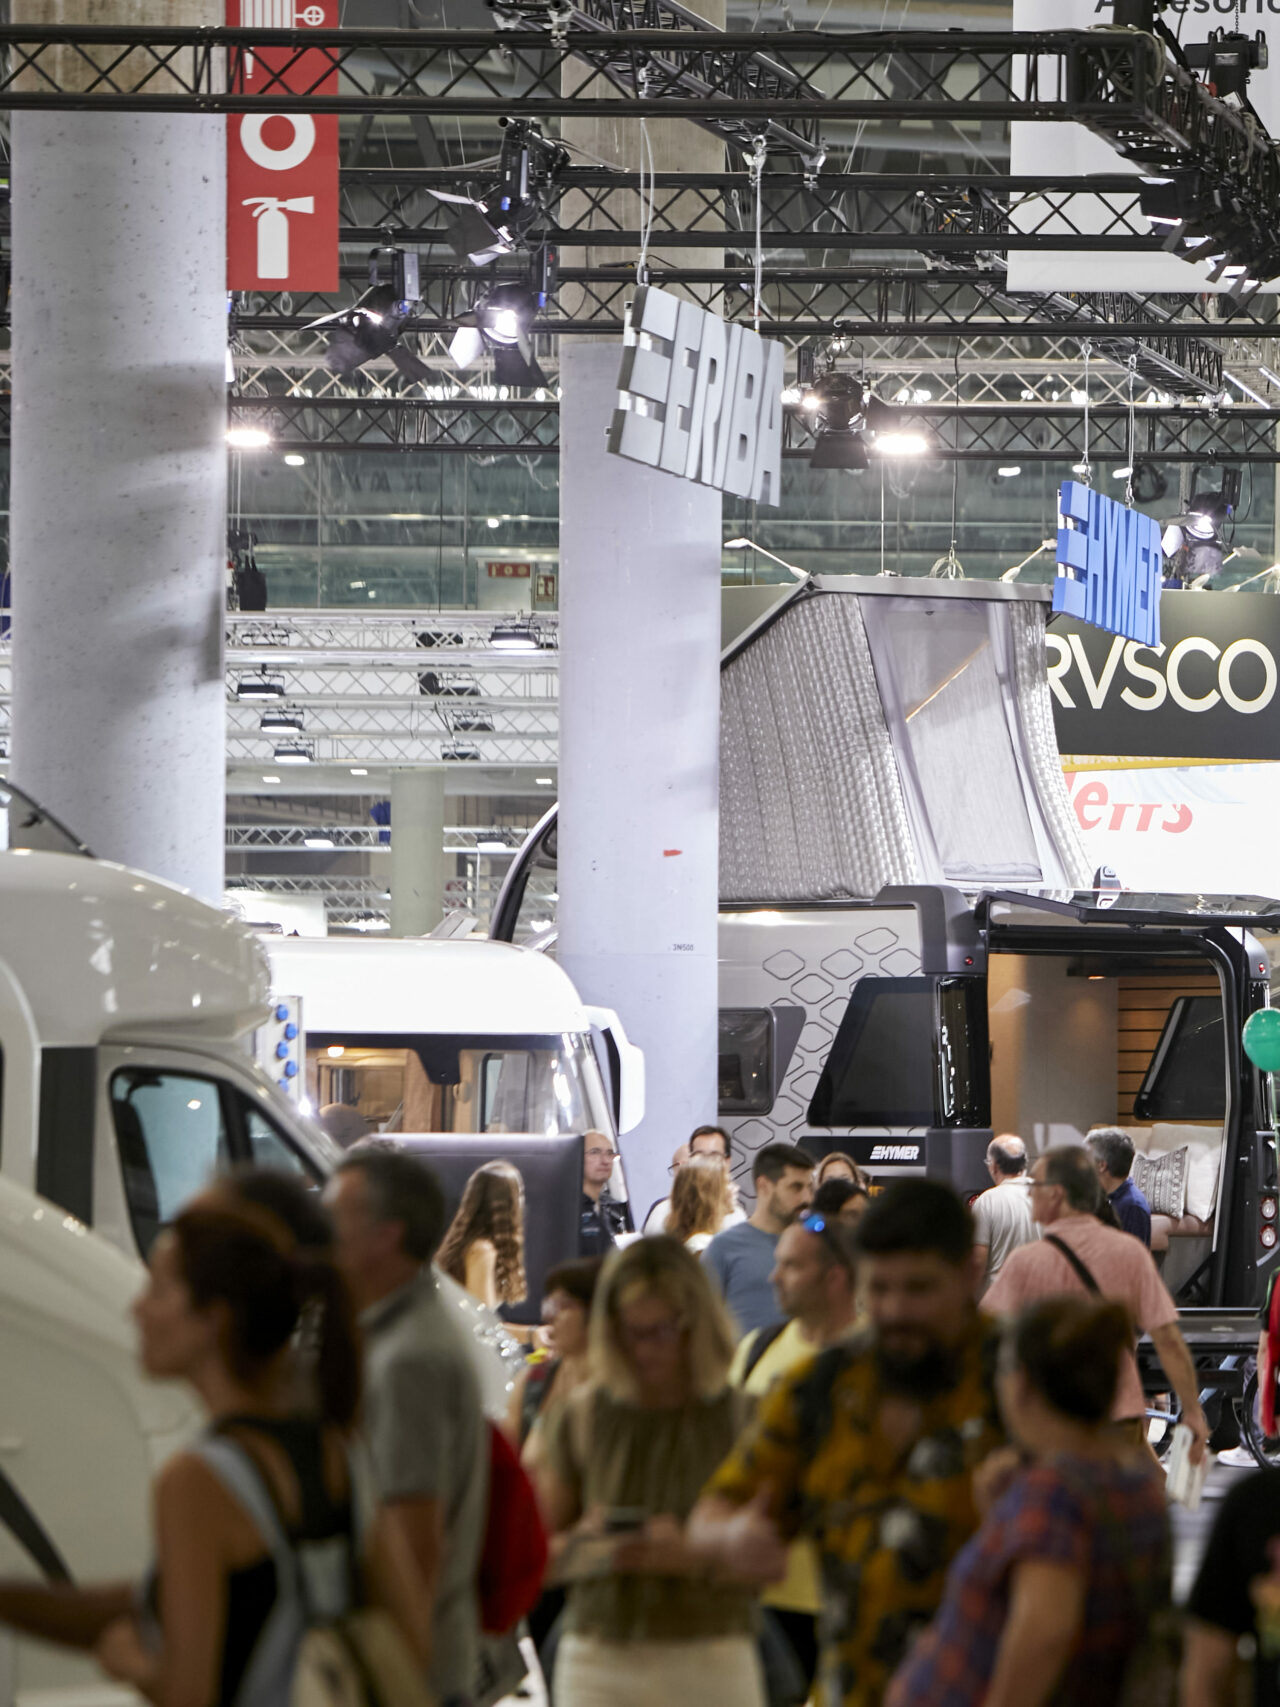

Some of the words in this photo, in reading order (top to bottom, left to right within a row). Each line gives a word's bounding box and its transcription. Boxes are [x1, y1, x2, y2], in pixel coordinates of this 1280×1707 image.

[657, 299, 785, 508] ERIBA
[1083, 488, 1163, 648] HYMER
[878, 1145, 920, 1160] HYMER
